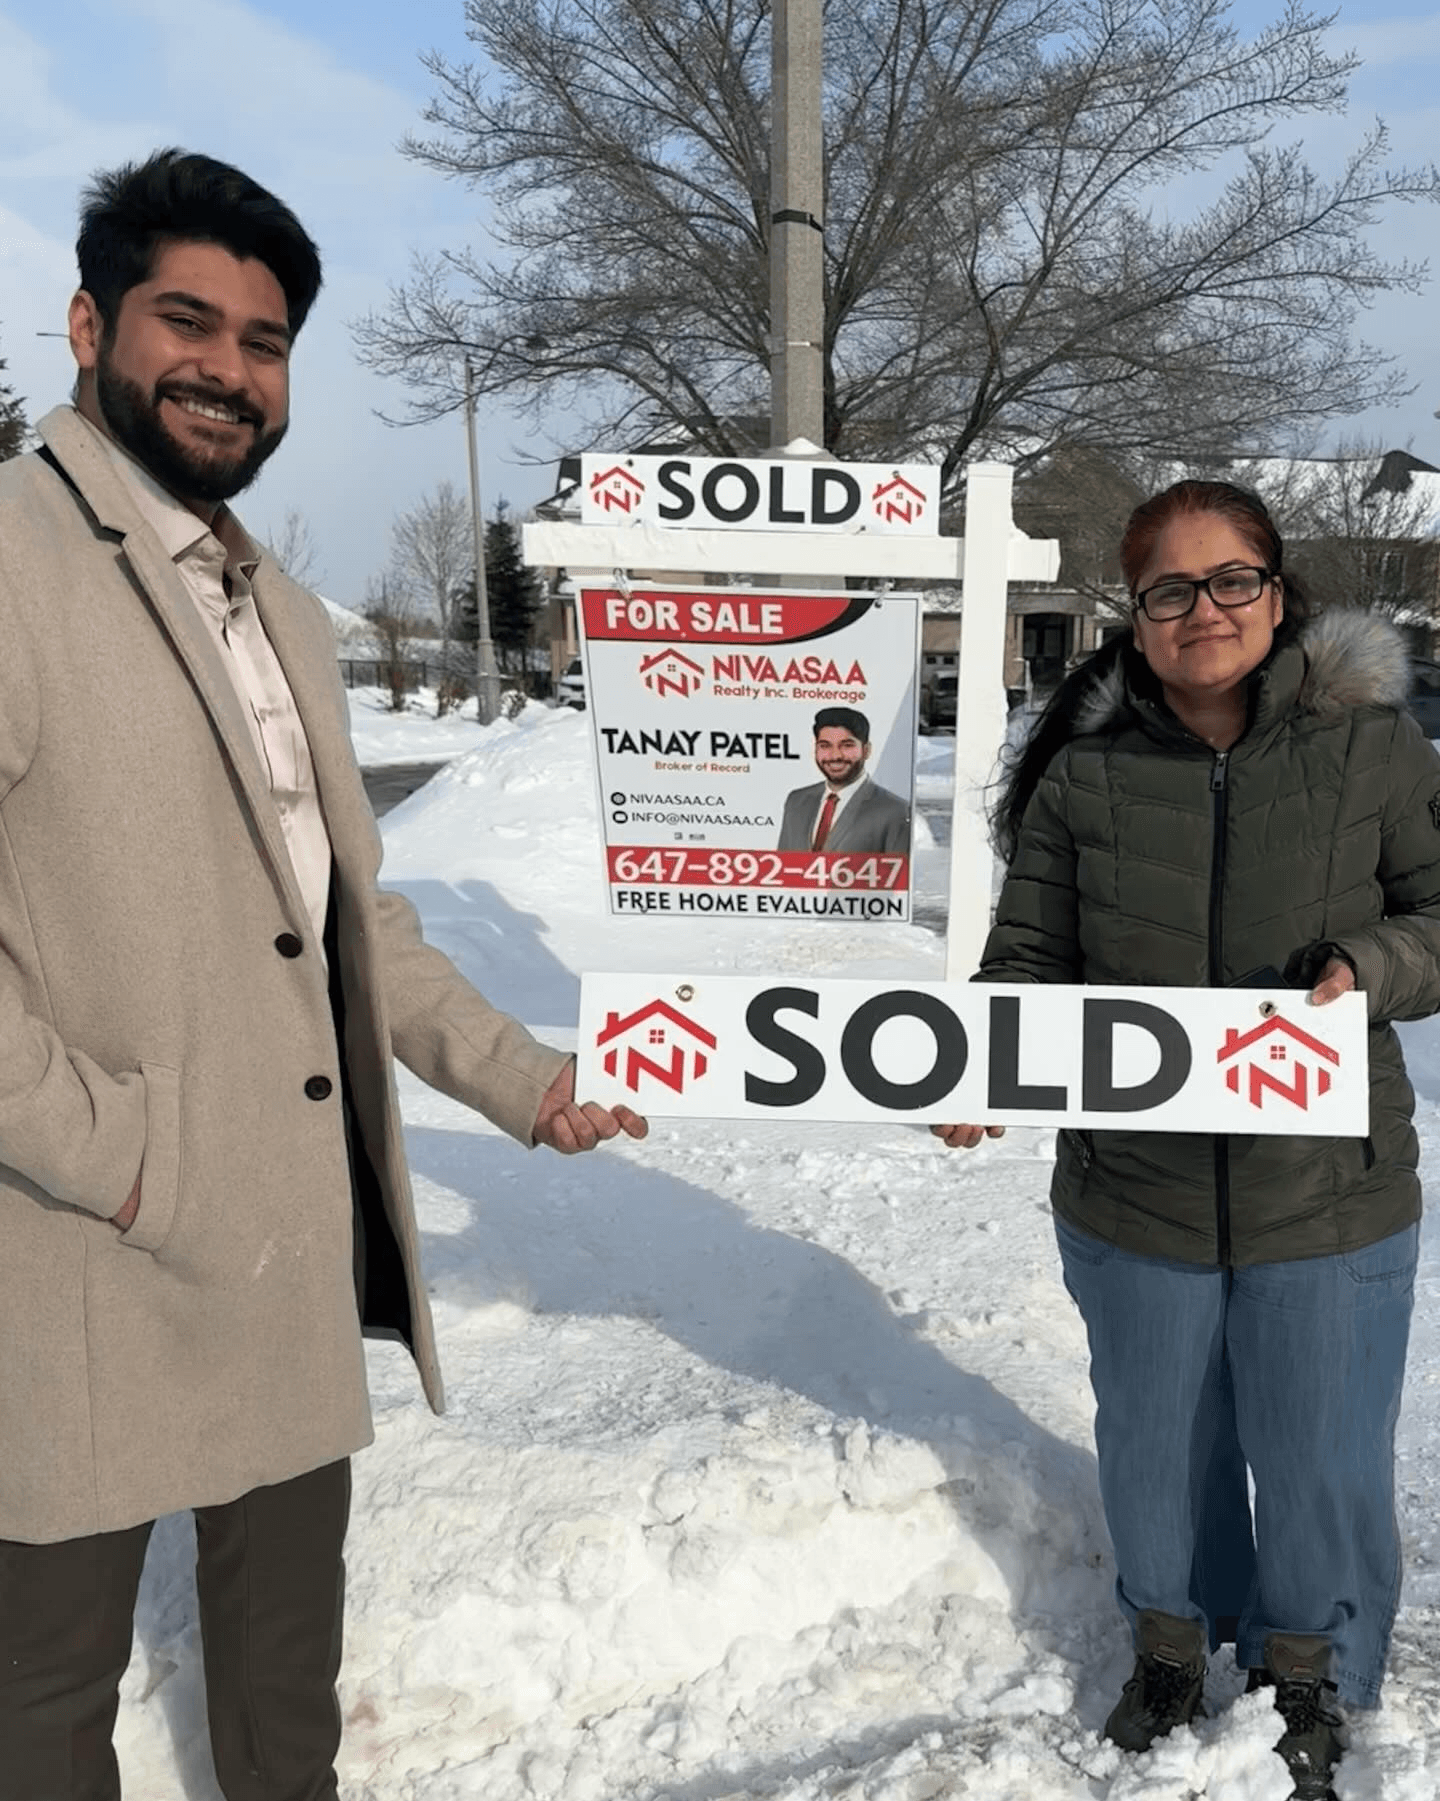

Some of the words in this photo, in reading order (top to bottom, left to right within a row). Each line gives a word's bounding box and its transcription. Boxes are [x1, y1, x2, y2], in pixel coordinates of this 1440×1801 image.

[657, 460, 861, 524] SOLD
[606, 599, 680, 631] FOR
[690, 602, 783, 634] SALE
[713, 655, 868, 685] NIVAASAA
[713, 685, 760, 700] Realty
[765, 687, 788, 699] Inc.
[792, 688, 866, 703] Brokerage
[601, 728, 702, 756] TANAY
[711, 732, 800, 759] PATEL
[654, 761, 693, 771] Broker
[697, 761, 708, 772] of
[710, 763, 750, 773] Record
[630, 793, 726, 806] NIVAASAA.CA
[631, 812, 775, 826] INFO@NIVAASAA.CA
[614, 850, 903, 888] 647-892-4647
[617, 890, 671, 911] FREE
[679, 893, 748, 912] HOME
[756, 895, 902, 916] EVALUATION
[744, 986, 1192, 1113] SOLD
